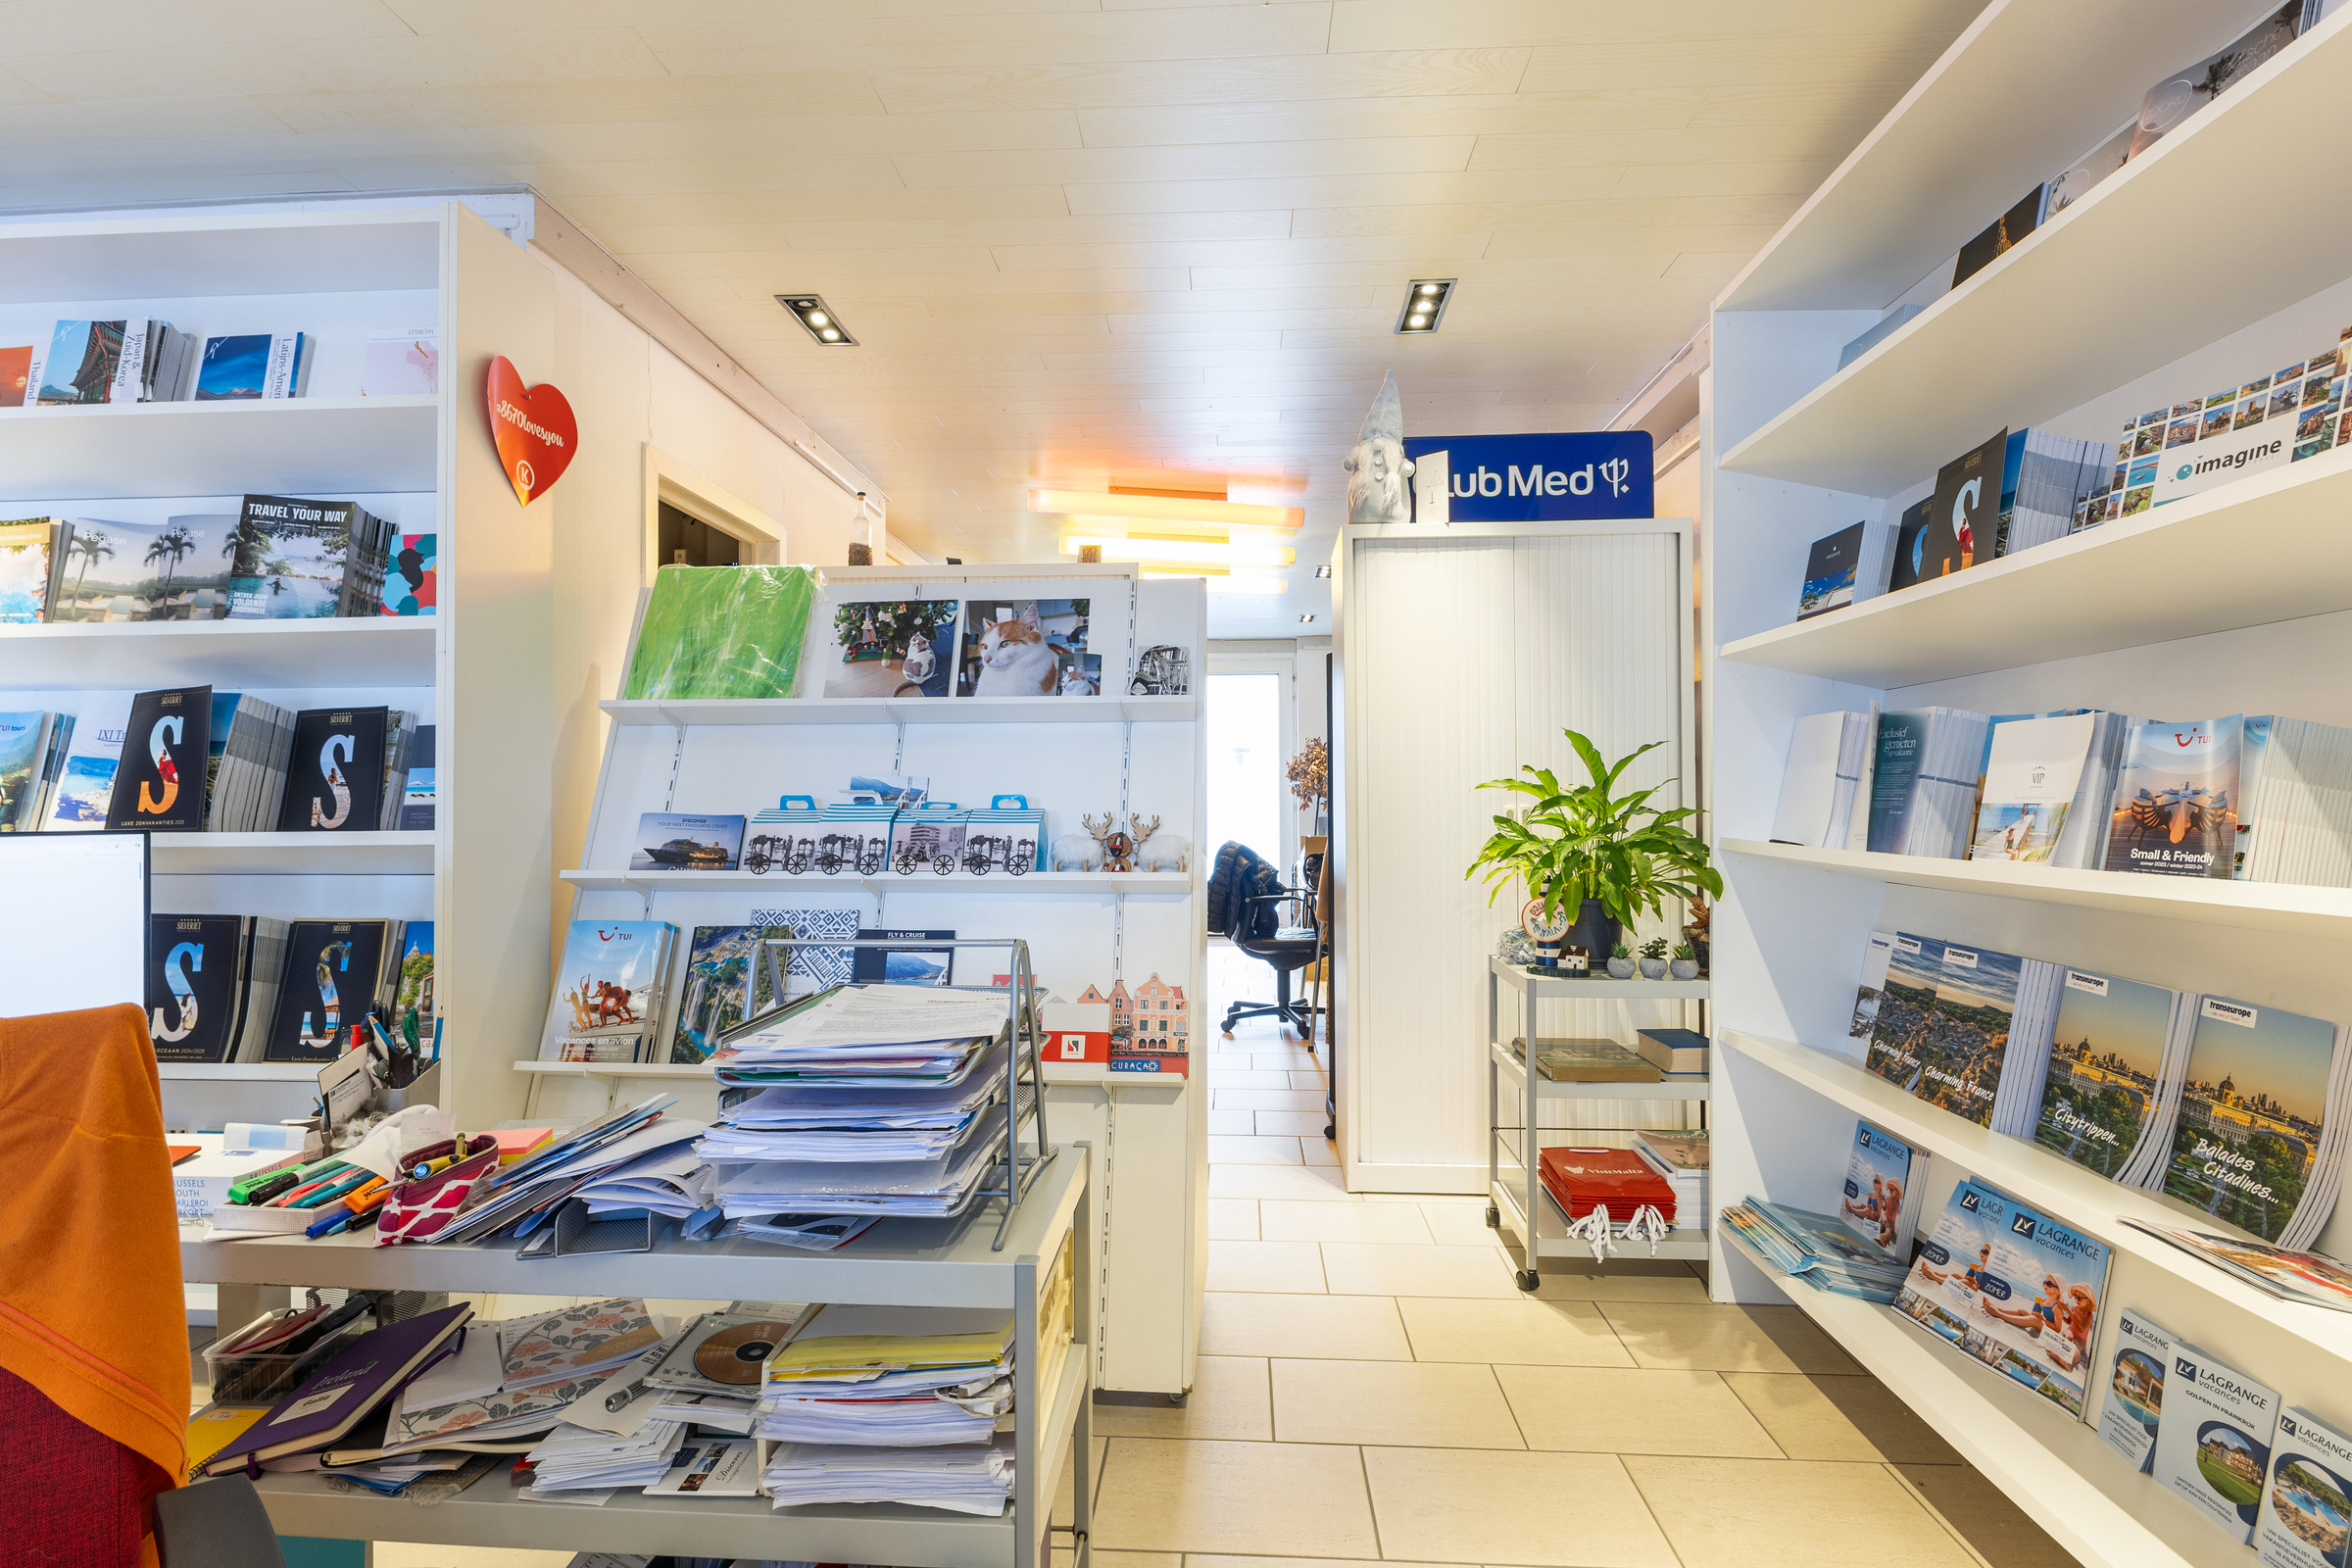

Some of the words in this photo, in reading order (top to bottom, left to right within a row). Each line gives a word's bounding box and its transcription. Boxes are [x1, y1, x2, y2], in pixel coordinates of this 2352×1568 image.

[131, 333, 145, 360] Japan
[118, 334, 135, 387] Zuid-Korea
[131, 361, 142, 369] &
[27, 360, 41, 400] Thailand
[2195, 440, 2281, 475] imagine
[1507, 464, 1594, 497] Med
[248, 503, 289, 518] TRAVEL
[293, 508, 321, 521] YOUR
[324, 511, 347, 522] WAY
[83, 531, 127, 546] Pegase
[172, 528, 205, 539] Pegase
[232, 598, 267, 608] VOLGENDE
[1885, 739, 1916, 753] genieten
[2197, 735, 2212, 744] TUI
[2033, 773, 2045, 784] VIP
[2131, 848, 2161, 860] Small
[2162, 851, 2172, 860] &
[2173, 851, 2215, 866] Friendly
[1898, 938, 1919, 948] transeurope
[1948, 950, 1975, 960] transeurope
[2072, 973, 2104, 987] transeurope
[2210, 1001, 2251, 1017] transeurope
[555, 1036, 596, 1045] Vacances
[610, 1036, 634, 1045] avion
[1874, 1040, 1901, 1061] Charming
[1902, 1052, 1921, 1068] France
[1925, 1065, 1964, 1092] Charming
[1966, 1080, 1994, 1102] France
[1871, 1146, 1890, 1161] vacances
[1872, 1135, 1905, 1159] LAGRANGE
[2195, 1138, 2256, 1172] Balades
[2035, 1235, 2076, 1260] vacances
[2037, 1223, 2100, 1260] LAGRANGE
[1925, 1250, 1945, 1263] ZOMER
[1984, 1283, 2007, 1299] ZOMER
[2132, 1333, 2157, 1349] vacances
[2134, 1325, 2169, 1349] LAGRANG
[311, 1360, 379, 1390] Ireland
[2198, 1380, 2241, 1405] vacances
[2199, 1368, 2268, 1409] LAGRANGE
[2185, 1390, 2212, 1406] GOLFEN
[2221, 1407, 2256, 1431] FRANKRIJK
[2116, 1413, 2136, 1432] SPECIALIST
[2297, 1435, 2330, 1457] vacances
[2298, 1425, 2352, 1462] LAGRANGE
[715, 1451, 743, 1481] Discover
[2176, 1476, 2195, 1491] ONTDEK
[2195, 1487, 2207, 1498] ONZE
[2206, 1494, 2232, 1517] RESIDENTIES
[2267, 1527, 2278, 1537] UW
[2278, 1534, 2311, 1559] SPECIALIST
